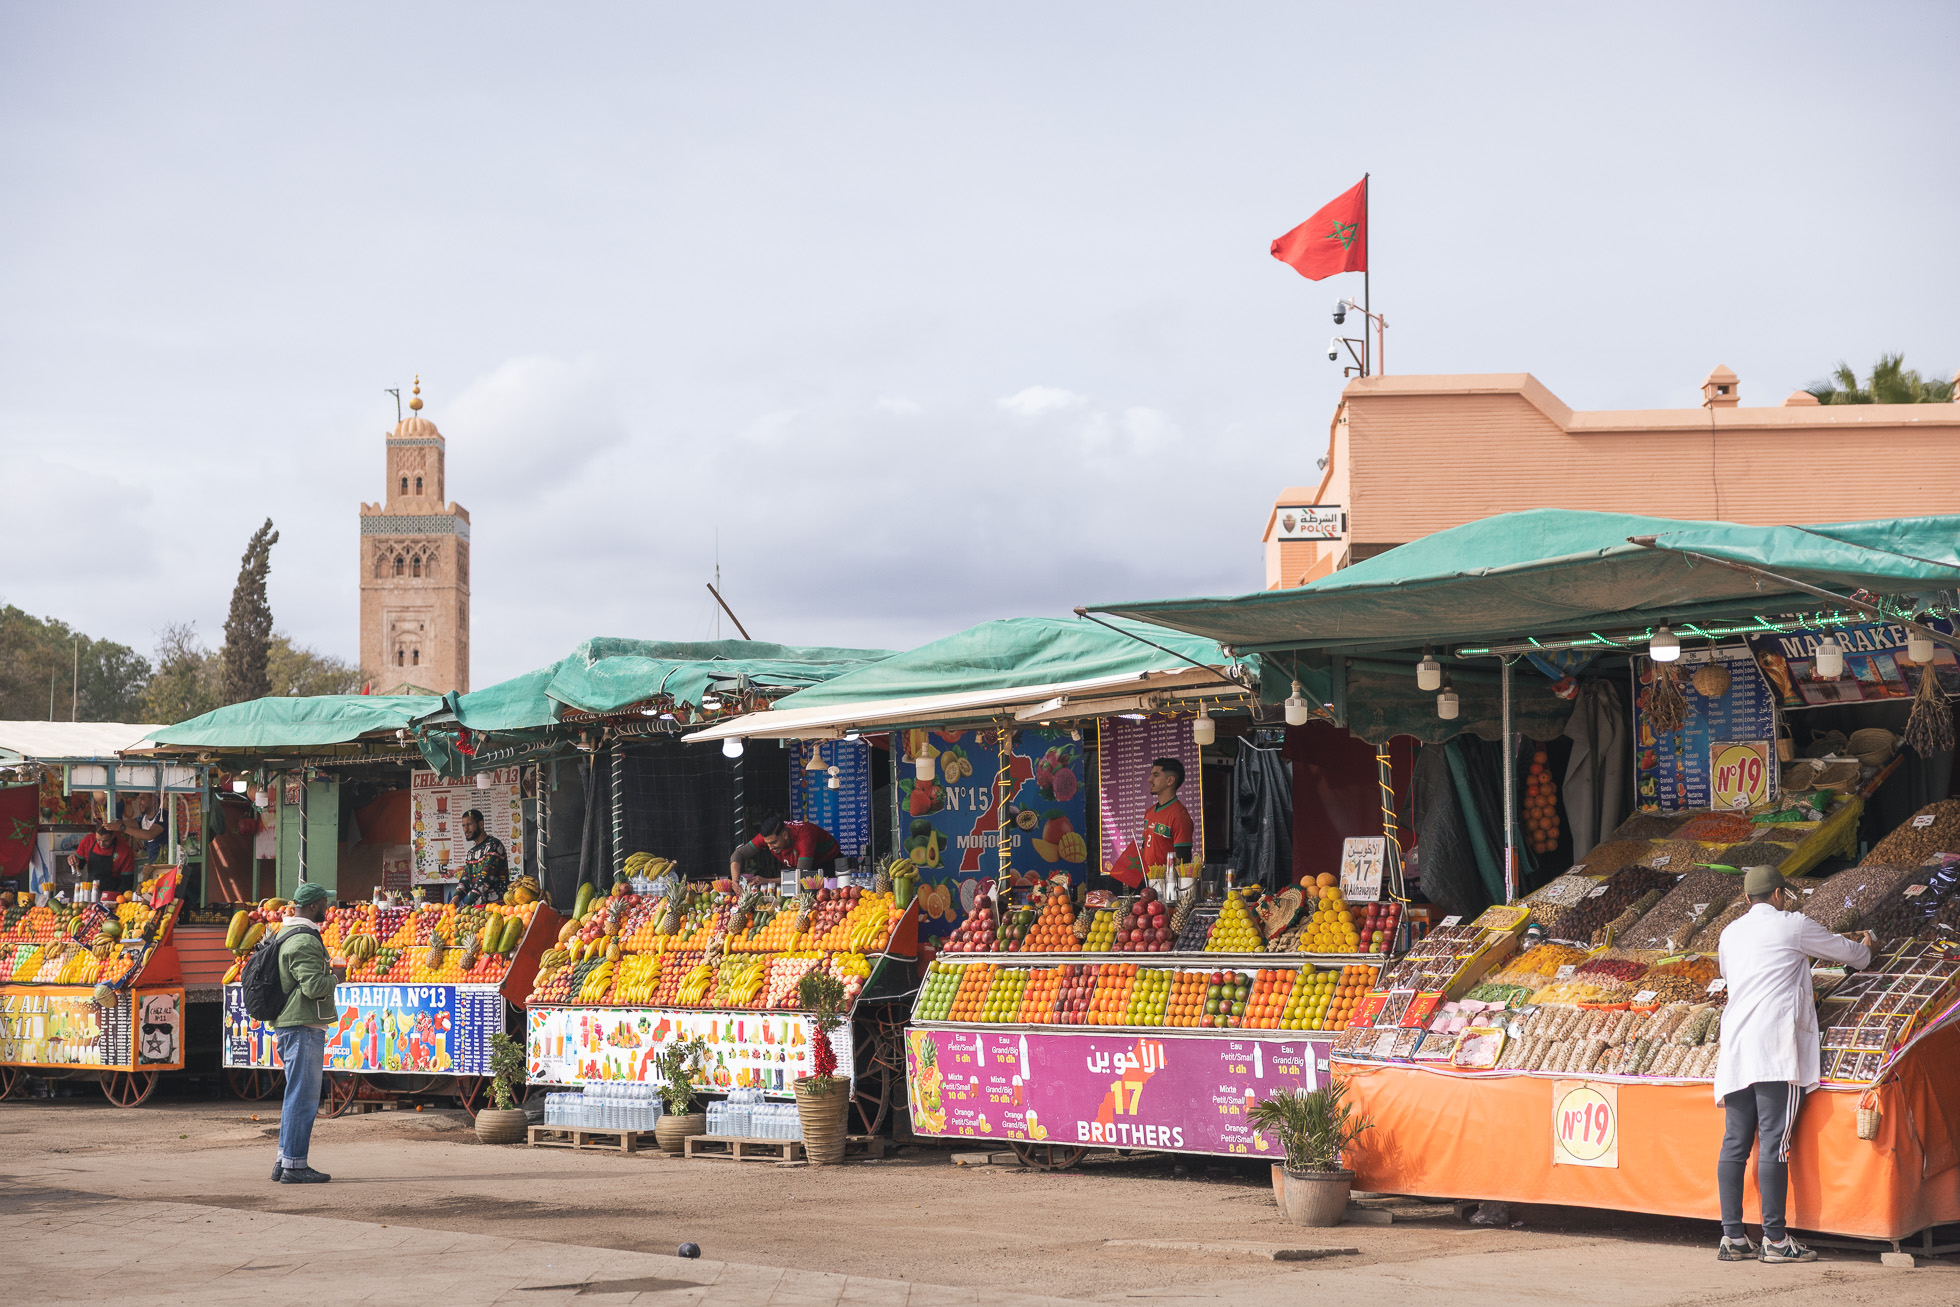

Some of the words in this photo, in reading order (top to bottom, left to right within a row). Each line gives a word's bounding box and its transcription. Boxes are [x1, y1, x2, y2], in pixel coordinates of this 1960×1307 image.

[1300, 513, 1336, 525] الشرطة
[506, 769, 518, 782] 13
[1717, 756, 1761, 795] N°19
[946, 786, 989, 810] N°15
[957, 834, 1021, 849] MOROO
[1147, 834, 1152, 848] 2
[1355, 860, 1372, 881] 17
[334, 988, 402, 1012] ALBAHJA
[407, 988, 446, 1008] N°13
[20, 996, 49, 1014] ALI
[14, 1017, 32, 1040] 11
[948, 1043, 976, 1052] Petit/Small
[992, 1047, 1018, 1056] Grand/Big
[1282, 1046, 1294, 1054] Eau
[1087, 1039, 1164, 1075] الأخوين
[1220, 1053, 1254, 1062] Petit/Small
[1272, 1056, 1304, 1066] Grand/Big
[1229, 1065, 1234, 1073] 5
[1236, 1065, 1246, 1073] dh
[1278, 1066, 1287, 1074] 10
[1289, 1066, 1300, 1074] dh
[986, 1086, 1012, 1095] Grand/Big
[1220, 1085, 1236, 1093] Mixte
[957, 1091, 966, 1100] dh
[1000, 1095, 1010, 1103] dh
[1110, 1080, 1143, 1115] 17
[1212, 1096, 1245, 1104] Petit/Small
[1219, 1106, 1228, 1114] 10
[1229, 1106, 1240, 1114] dh
[1004, 1112, 1023, 1120] Orange
[952, 1118, 979, 1126] Petit/Small
[1002, 1121, 1027, 1130] Grand/Big
[1562, 1102, 1609, 1146] N°19
[1225, 1124, 1248, 1132] Orange
[1016, 1131, 1024, 1139] dh
[1078, 1120, 1184, 1148] BROTHERS
[1221, 1135, 1254, 1144] Petit/Small
[1236, 1144, 1247, 1153] dh
